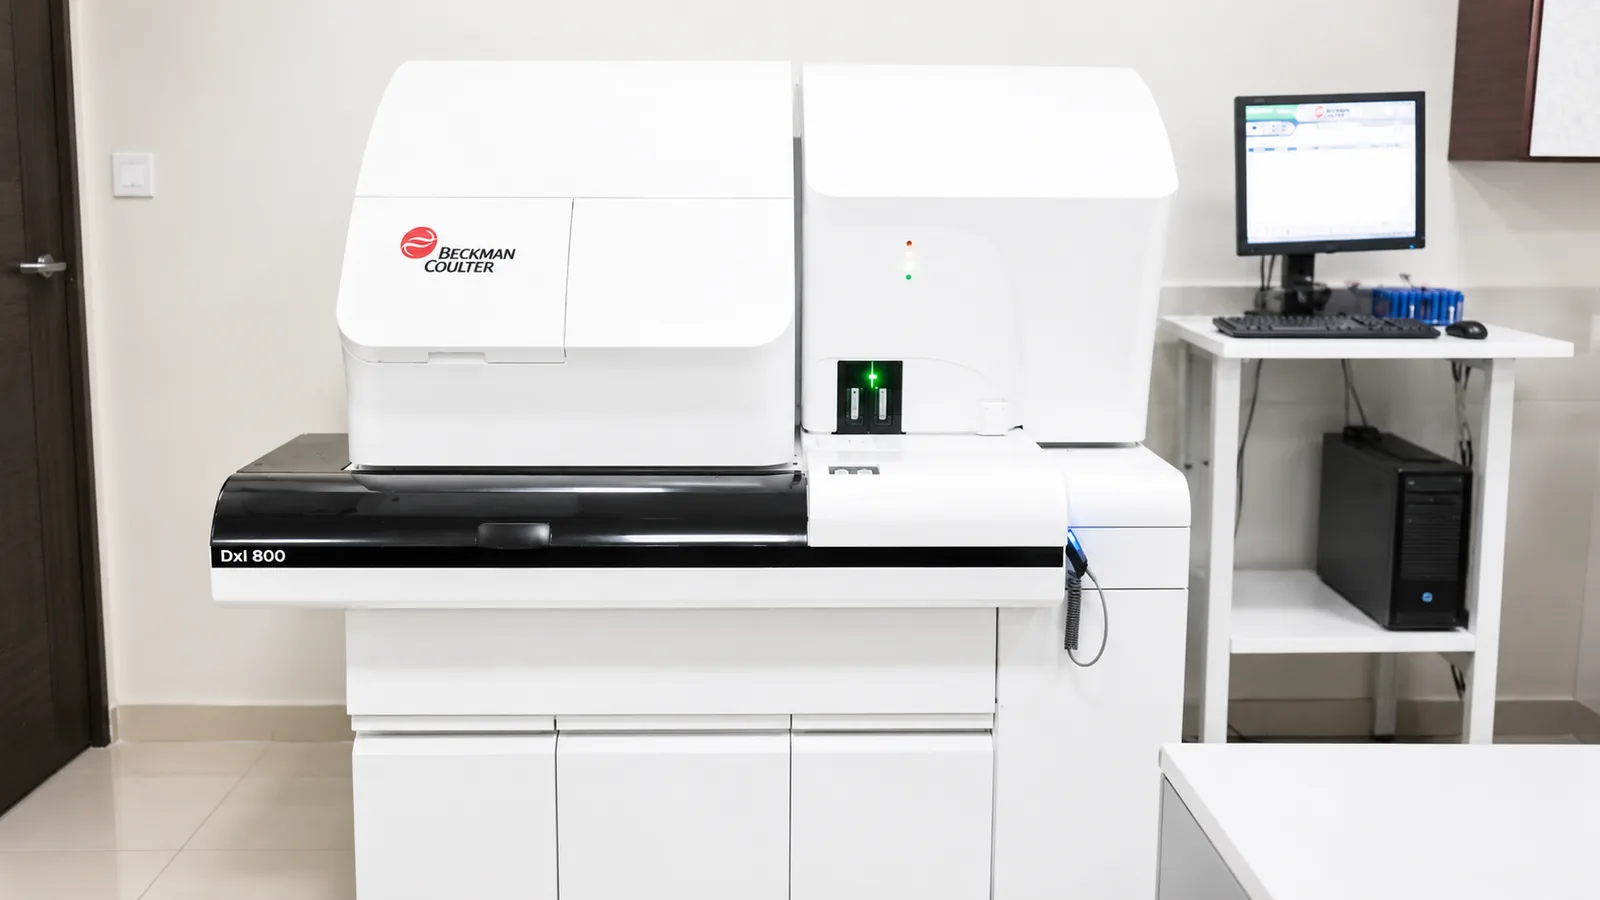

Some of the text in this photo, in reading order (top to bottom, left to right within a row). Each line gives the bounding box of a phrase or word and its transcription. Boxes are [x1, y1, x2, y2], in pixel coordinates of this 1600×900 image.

[439, 247, 516, 260] BECKMAN
[424, 259, 495, 273] COULTER
[252, 549, 286, 563] 800
